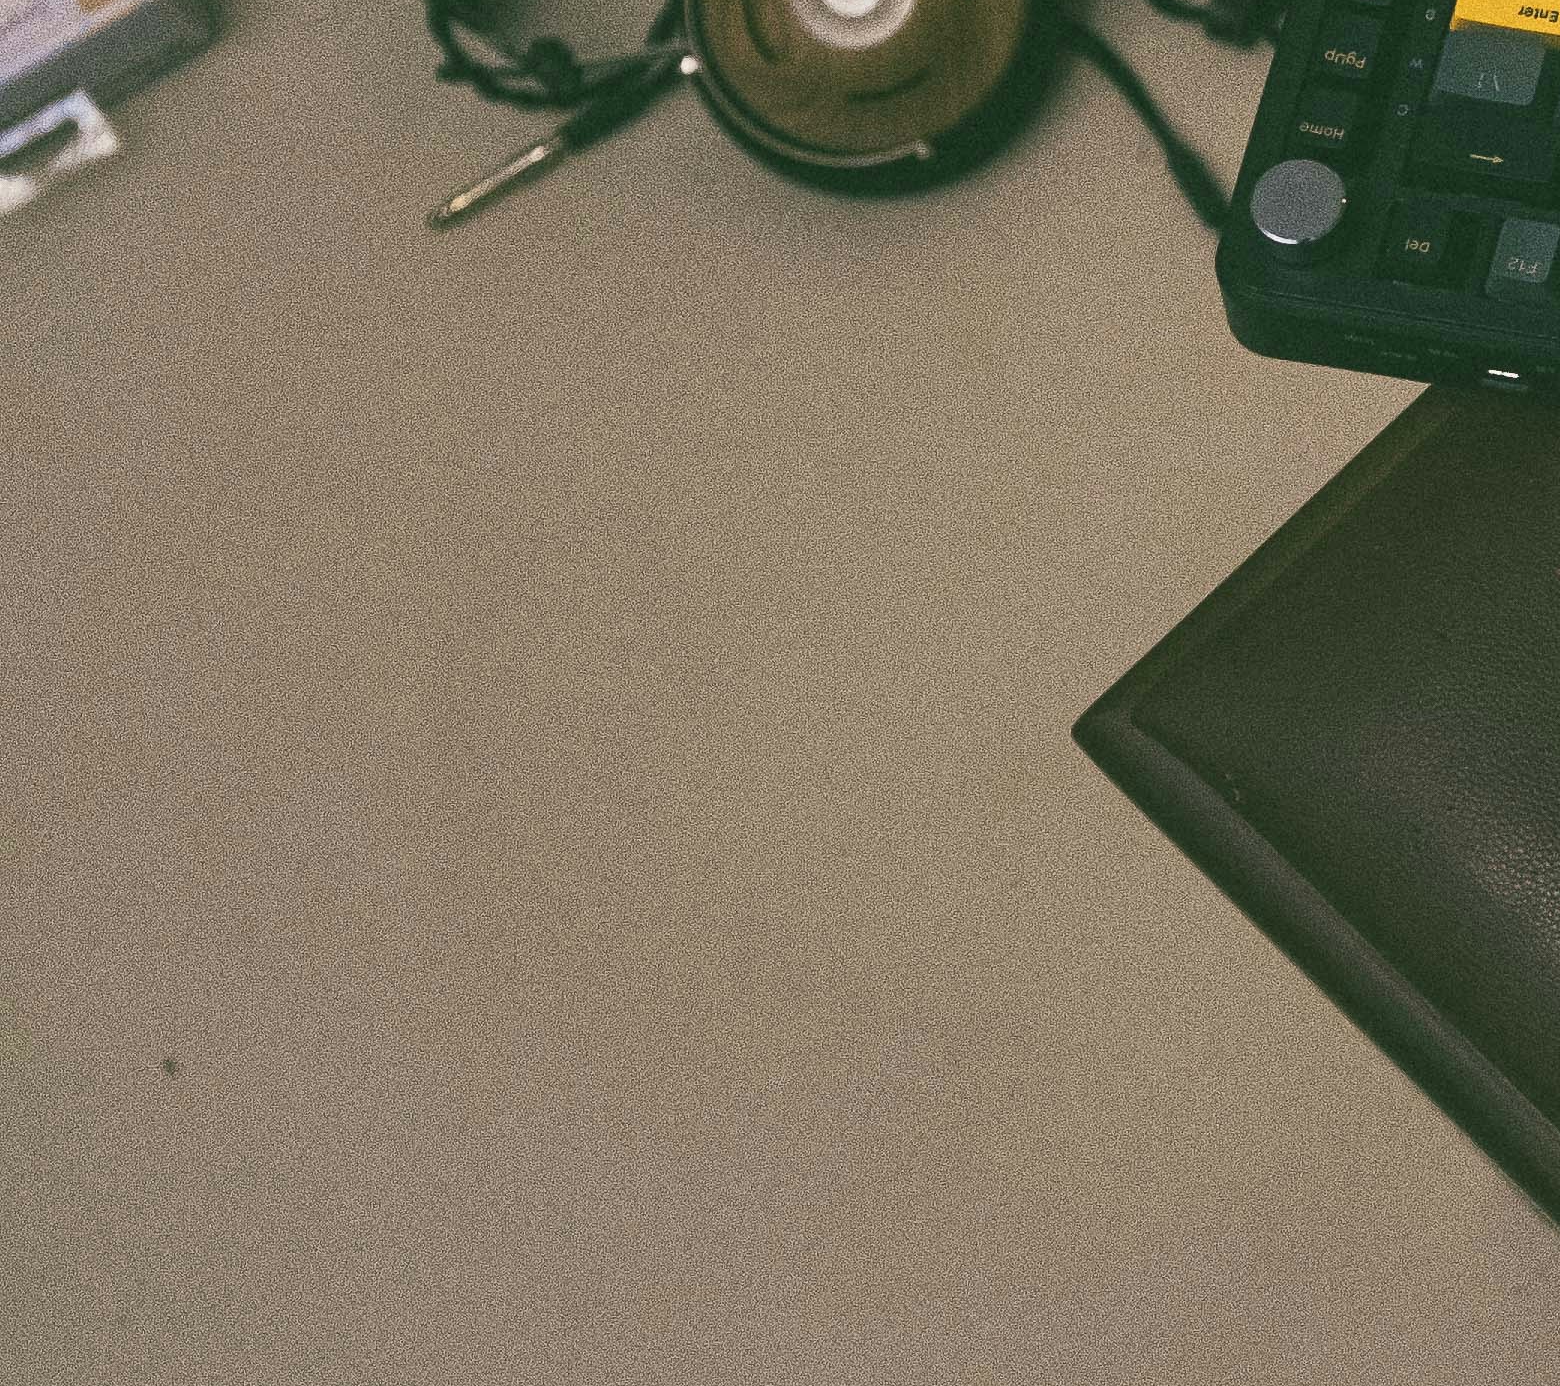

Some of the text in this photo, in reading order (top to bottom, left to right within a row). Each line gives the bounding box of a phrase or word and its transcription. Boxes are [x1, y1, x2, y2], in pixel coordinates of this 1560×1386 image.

[1516, 2, 1559, 24] Enter
[1322, 45, 1367, 68] PgUp
[1297, 120, 1344, 139] Home
[1403, 236, 1430, 255] Del
[1506, 255, 1538, 274] F12
